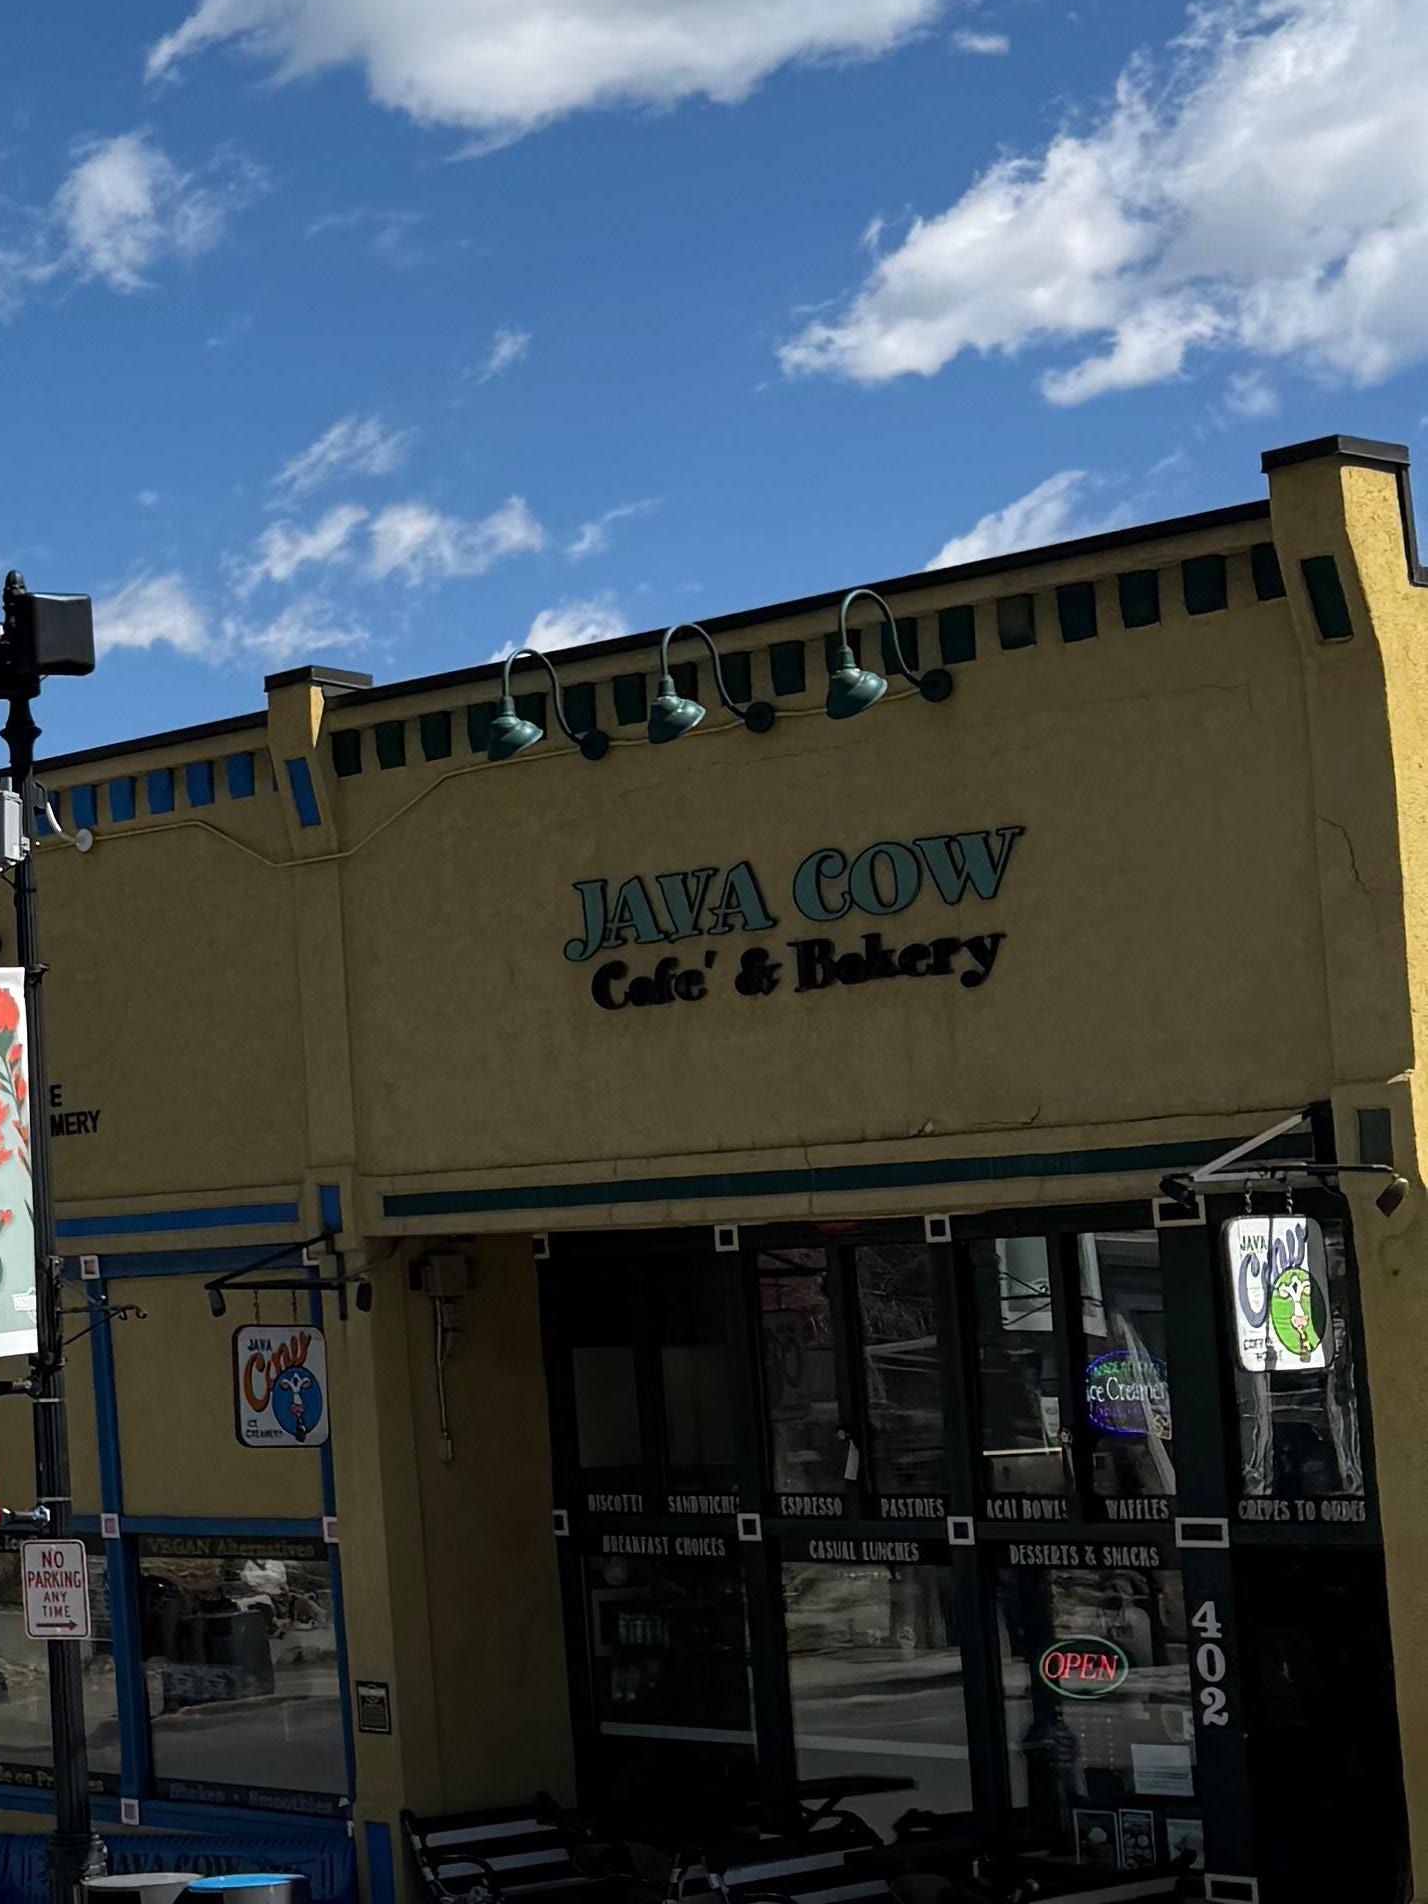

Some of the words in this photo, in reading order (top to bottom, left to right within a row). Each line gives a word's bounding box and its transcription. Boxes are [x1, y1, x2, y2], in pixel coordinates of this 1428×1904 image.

[564, 860, 777, 961] JAVA
[793, 825, 1025, 922] COW
[734, 947, 782, 995] &
[788, 933, 1006, 993] Bakery
[50, 1110, 100, 1136] MERY
[247, 1339, 272, 1351] JAVA
[588, 1494, 643, 1512] BISCOTTI
[780, 1498, 843, 1516] ESPRESSO
[881, 1498, 944, 1518] PASTRIES
[986, 1499, 1017, 1519] ACAI
[1105, 1499, 1170, 1520] WAFFLES
[1238, 1500, 1290, 1521] CREPES
[1294, 1500, 1316, 1521] TO
[147, 1537, 211, 1556] VEGAN
[217, 1538, 315, 1558] Alternatives
[602, 1535, 669, 1556] BREAKFAST
[675, 1537, 727, 1557] CHOICES
[808, 1540, 857, 1560] CASUAL
[861, 1541, 920, 1562] LUNCHES
[1009, 1545, 1079, 1566] DESSERTS
[1103, 1546, 1160, 1568] SNACKS
[42, 1551, 64, 1568] NO
[28, 1570, 81, 1588] PARKING
[44, 1591, 67, 1603] ANY
[43, 1605, 71, 1617] TIME
[1044, 1651, 1120, 1680] OPEN
[1191, 1601, 1230, 1727] 402
[14, 1772, 33, 1785] on
[248, 1789, 334, 1814] Smoothies
